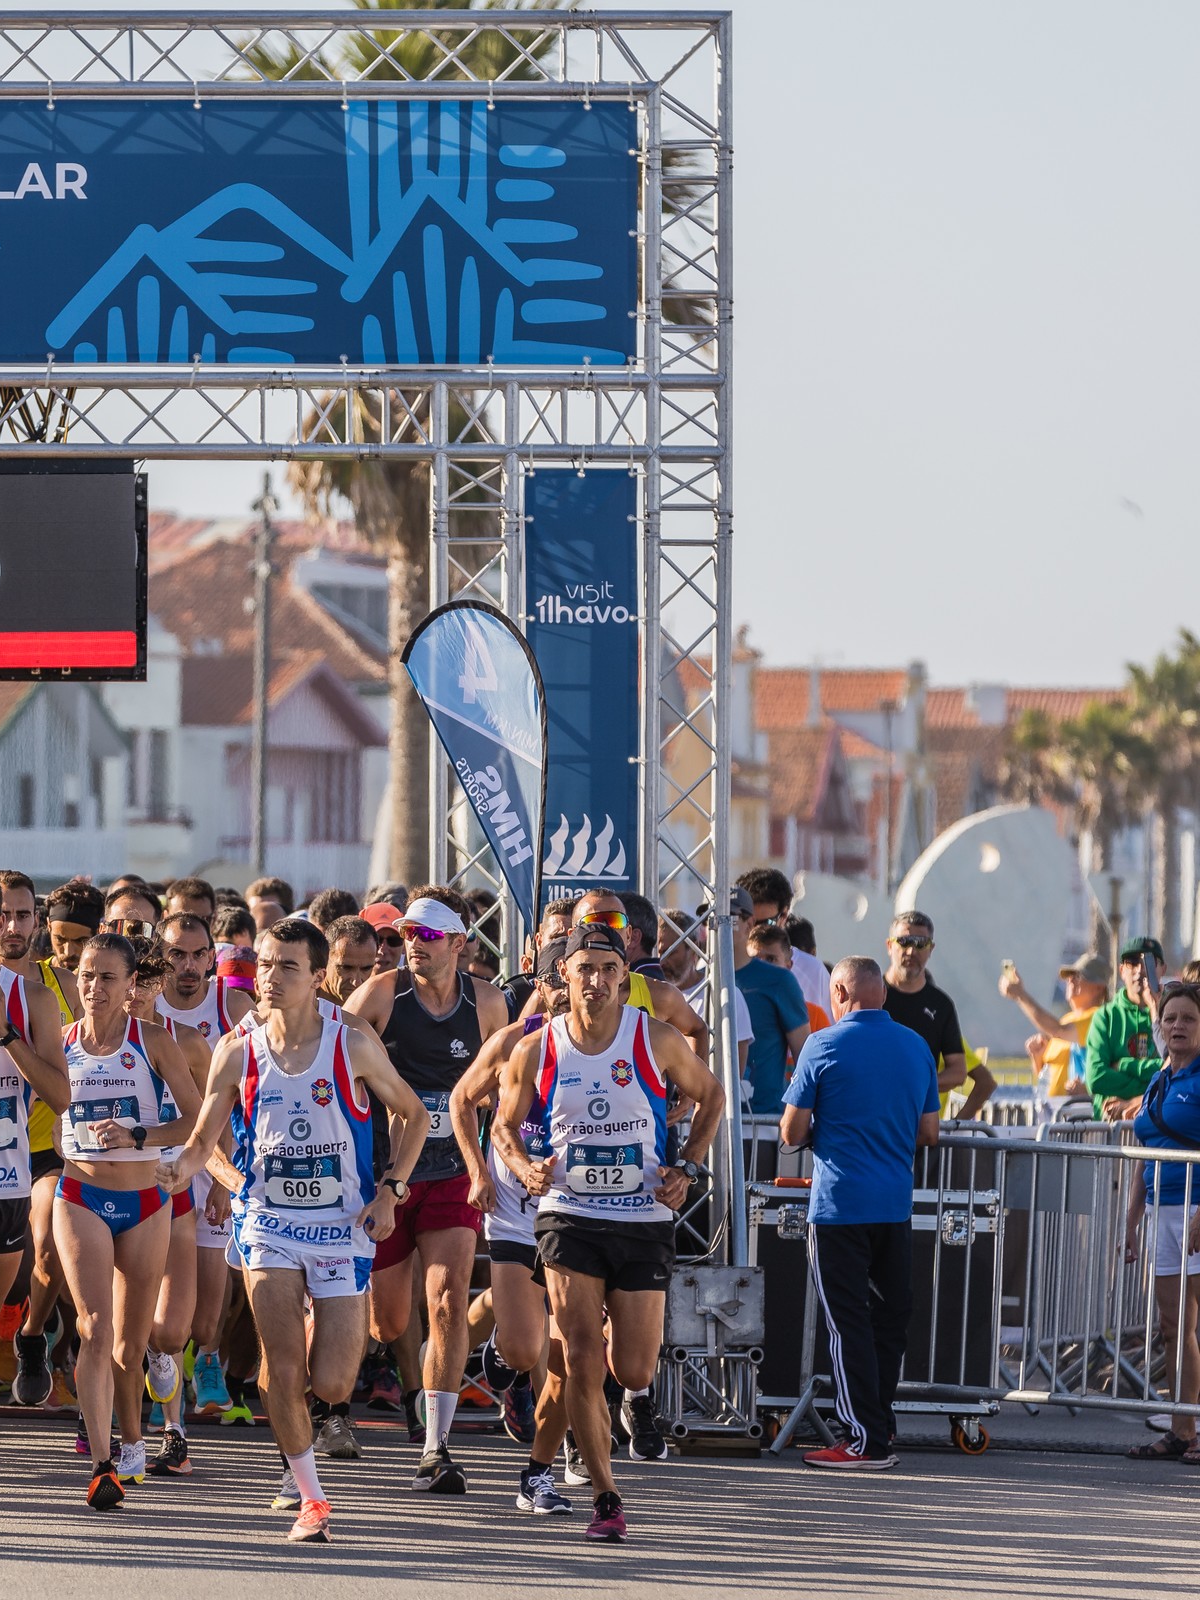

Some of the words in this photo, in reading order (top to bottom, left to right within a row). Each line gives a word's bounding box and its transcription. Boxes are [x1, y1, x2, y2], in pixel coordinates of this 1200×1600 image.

[565, 580, 614, 604] visit
[585, 1168, 623, 1184] 612
[283, 1180, 321, 1198] 606
[254, 1214, 279, 1229] RD
[280, 1221, 352, 1240] ÁGUEDA
